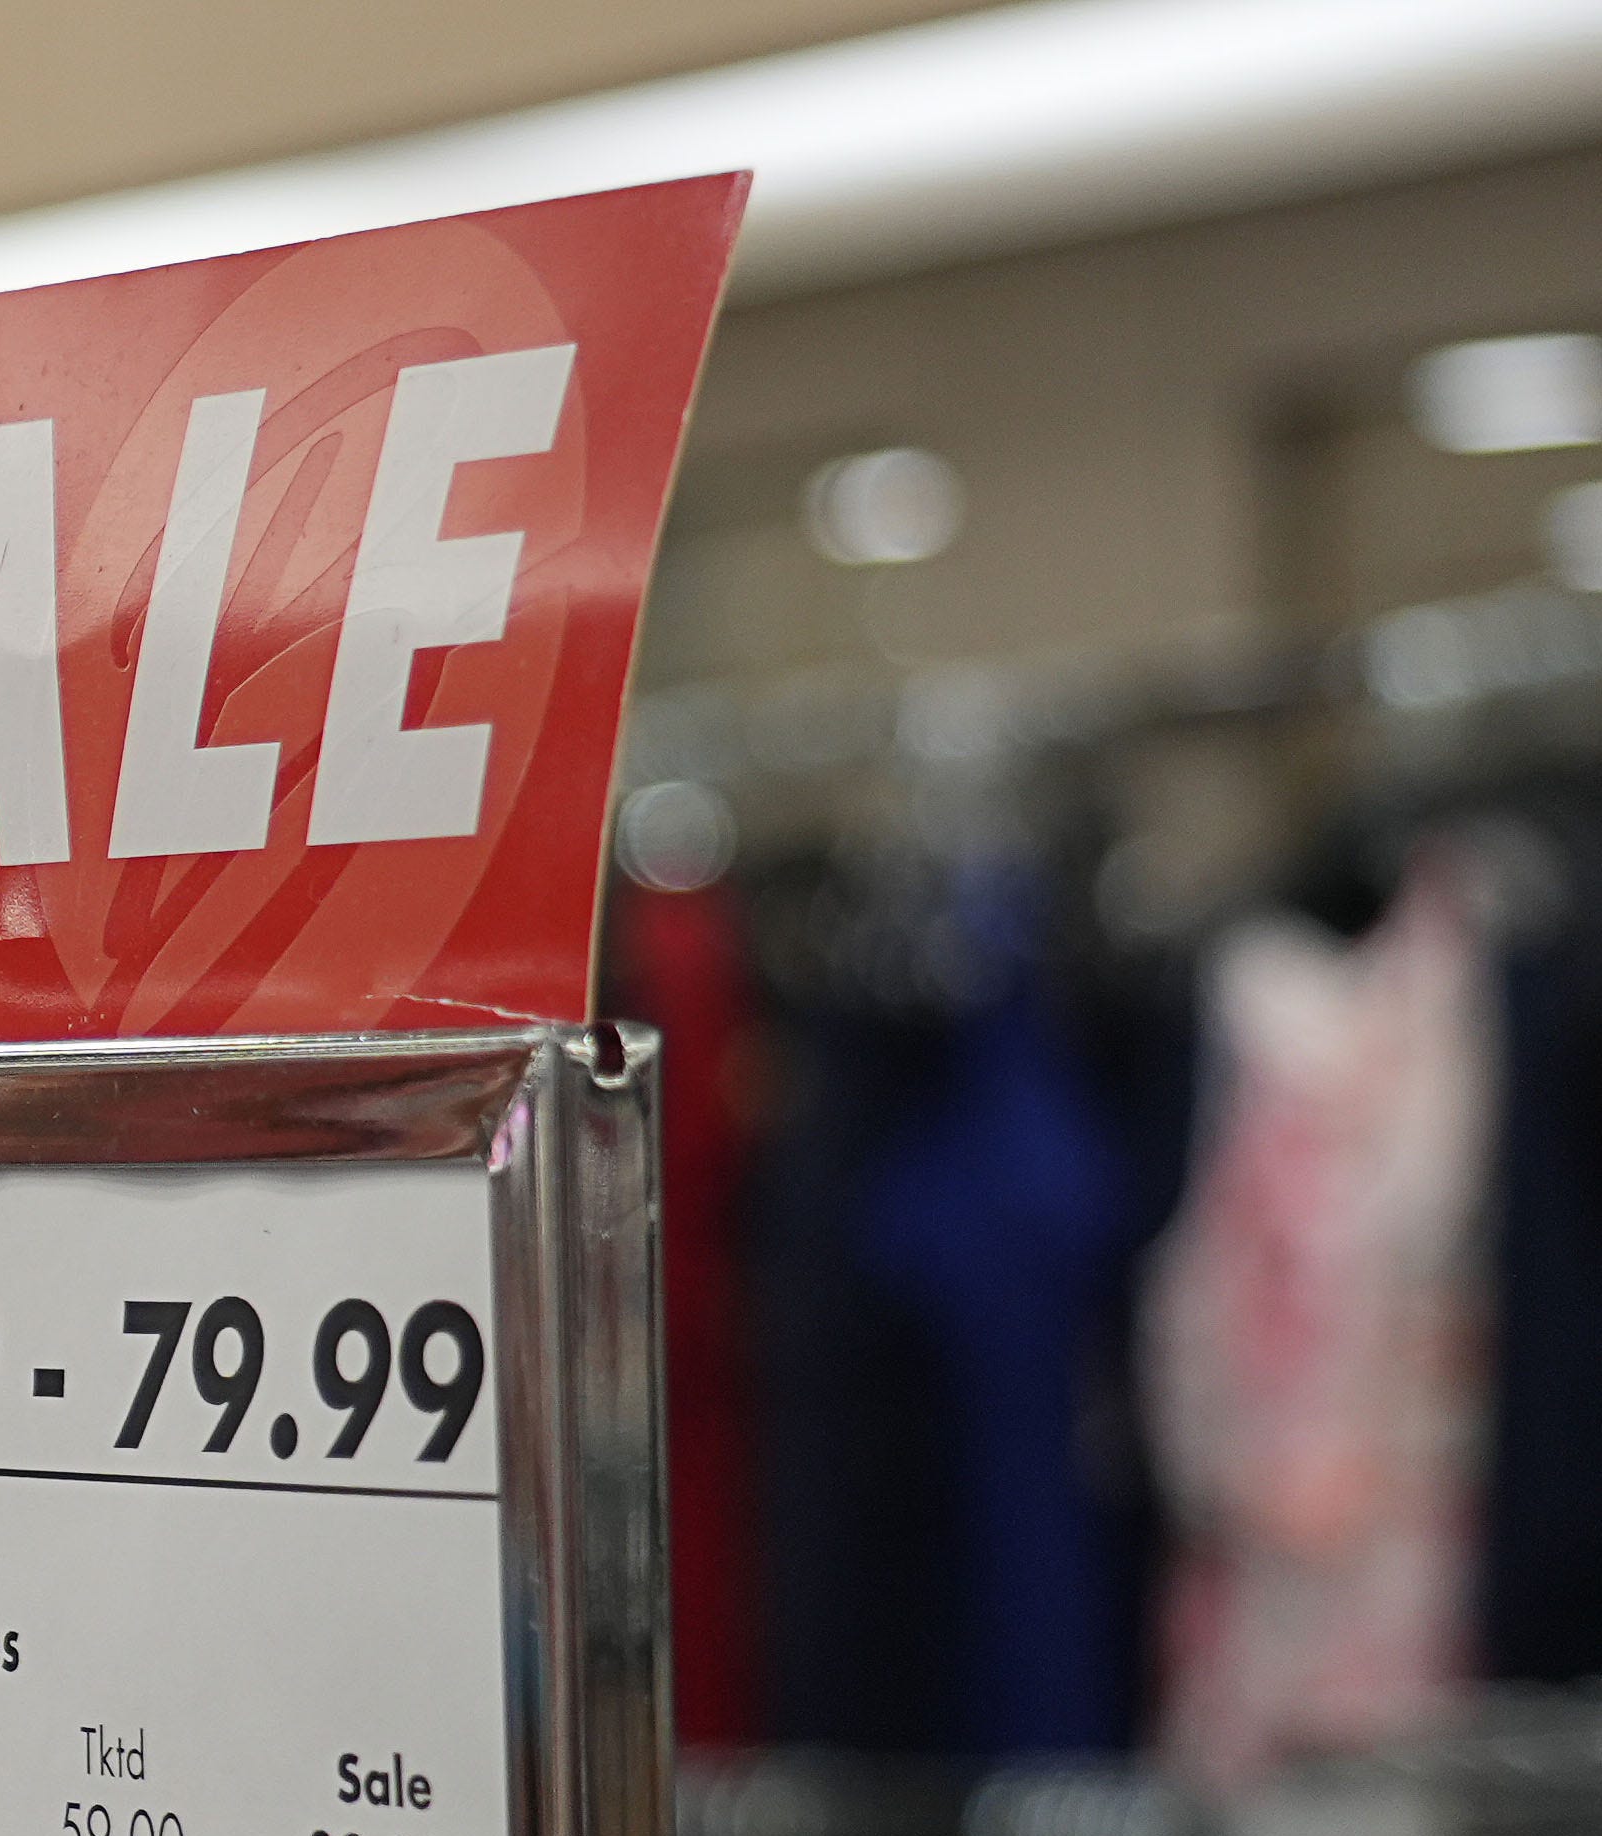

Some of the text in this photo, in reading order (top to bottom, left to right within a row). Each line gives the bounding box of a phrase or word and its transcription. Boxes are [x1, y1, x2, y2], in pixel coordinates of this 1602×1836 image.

[33, 1368, 65, 1398] -
[113, 1296, 485, 1463] 79.99
[80, 1724, 431, 1810] Tktd Sale
